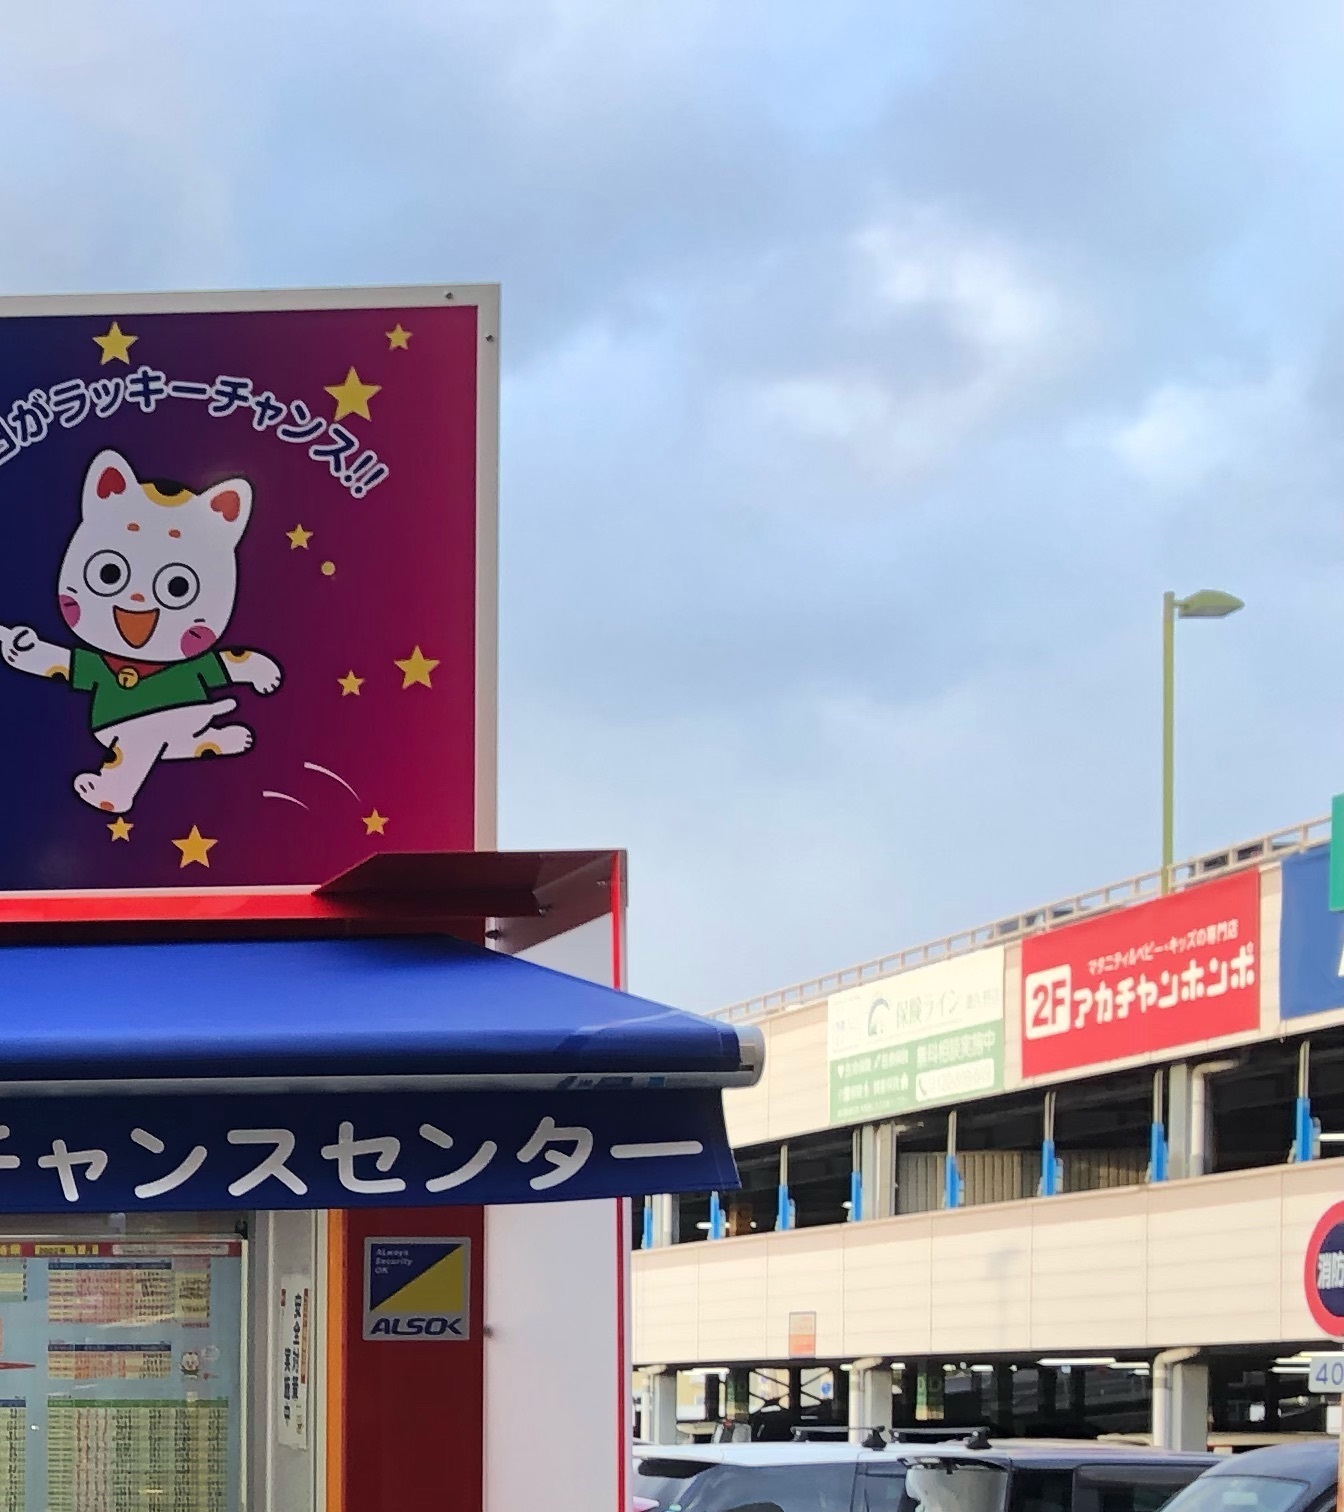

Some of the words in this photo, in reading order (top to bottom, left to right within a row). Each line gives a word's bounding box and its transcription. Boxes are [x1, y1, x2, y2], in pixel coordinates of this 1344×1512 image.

[1032, 979, 1067, 1028] 2F
[1074, 941, 1255, 1029] アカチャンホンポ
[370, 1317, 462, 1336] ALSOK
